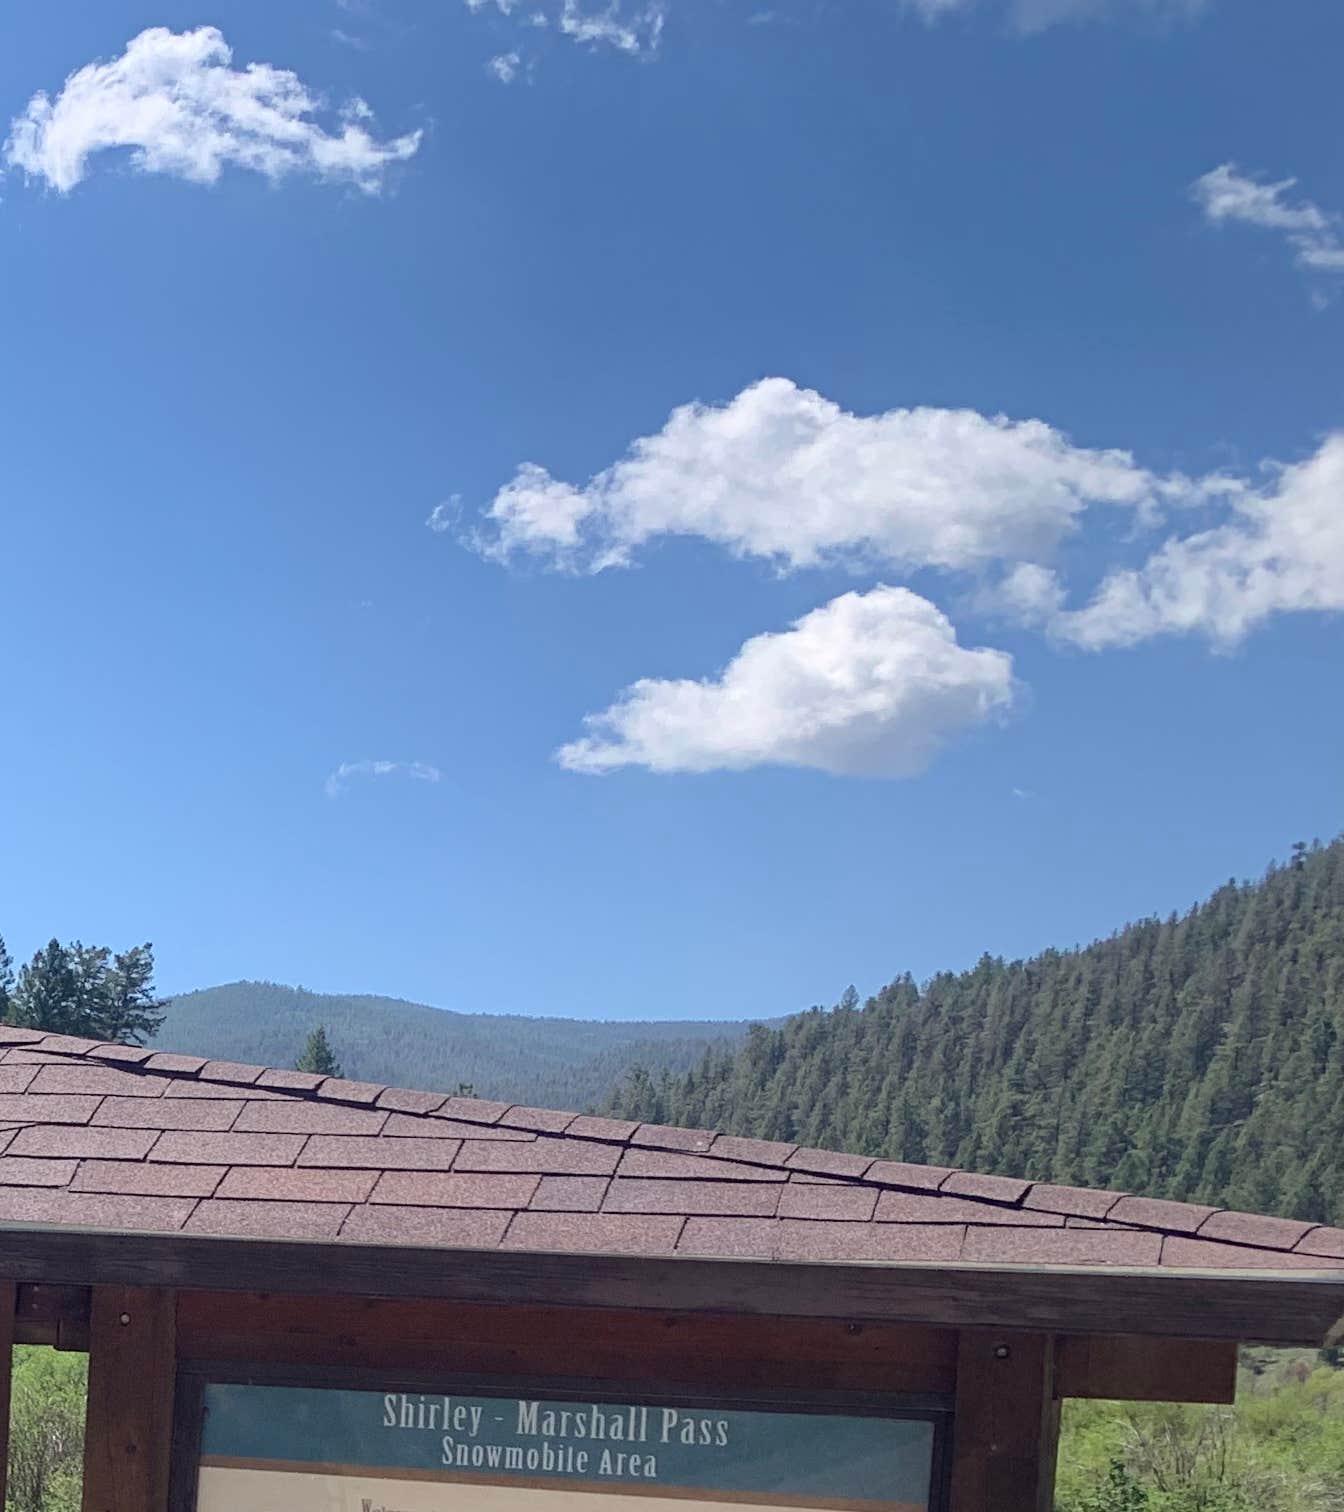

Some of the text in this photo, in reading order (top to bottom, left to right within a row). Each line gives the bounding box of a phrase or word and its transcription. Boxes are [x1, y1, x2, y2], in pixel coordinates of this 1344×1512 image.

[384, 1394, 483, 1437] Shirley
[515, 1400, 648, 1442] Marshall
[659, 1407, 729, 1446] Pass
[442, 1436, 657, 1478] Snowmobile Area
